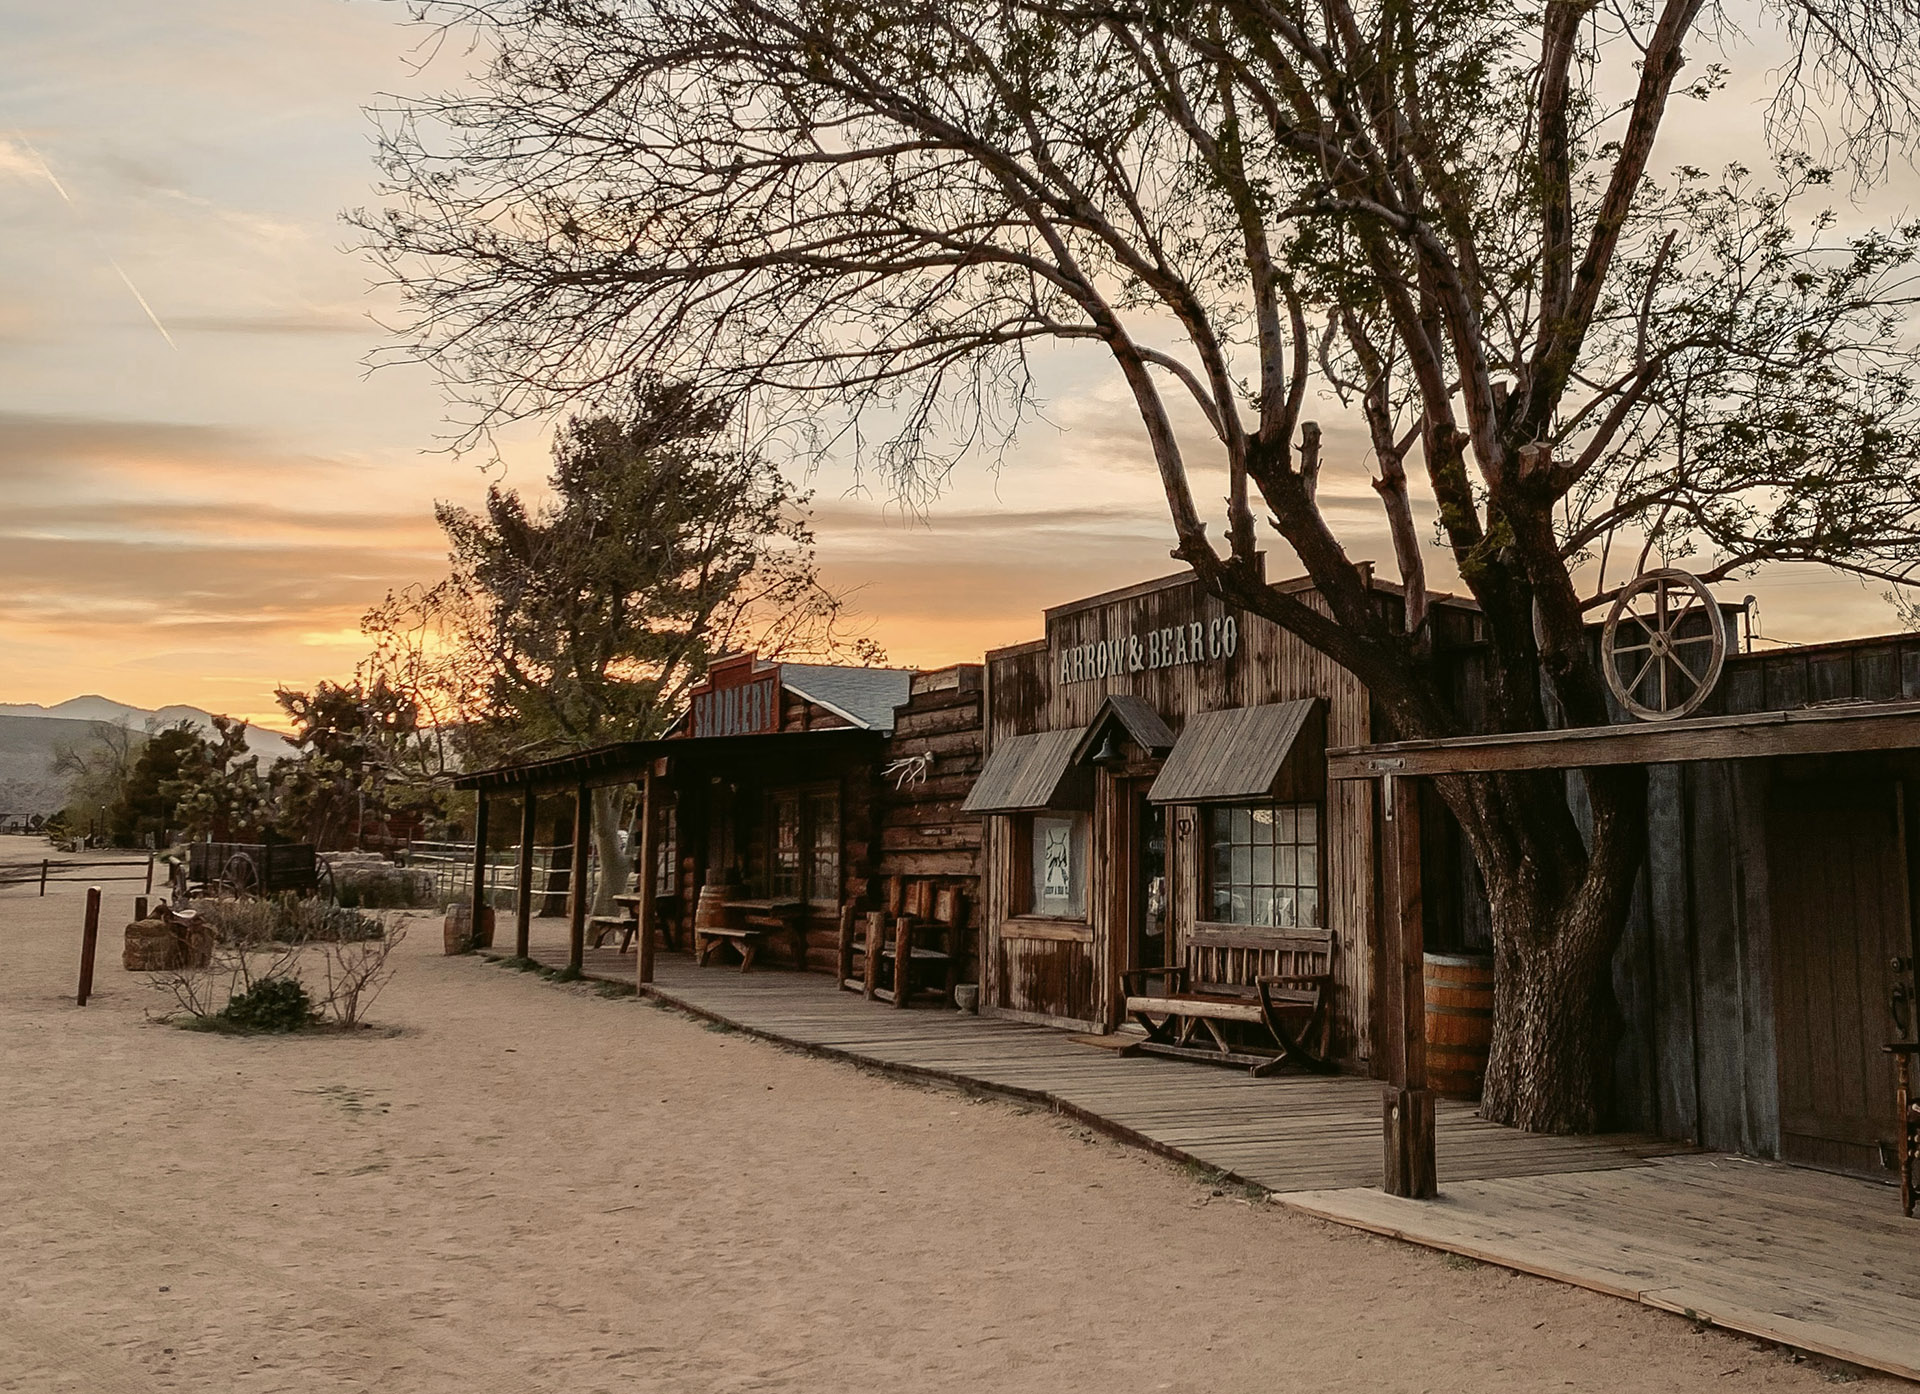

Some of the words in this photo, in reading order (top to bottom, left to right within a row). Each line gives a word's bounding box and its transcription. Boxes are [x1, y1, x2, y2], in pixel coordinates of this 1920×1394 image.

[1060, 637, 1127, 685] ARROW
[1128, 634, 1144, 673] &
[1148, 621, 1205, 670] BEAR
[1208, 615, 1238, 659] CO
[695, 679, 774, 738] SADDLERY
